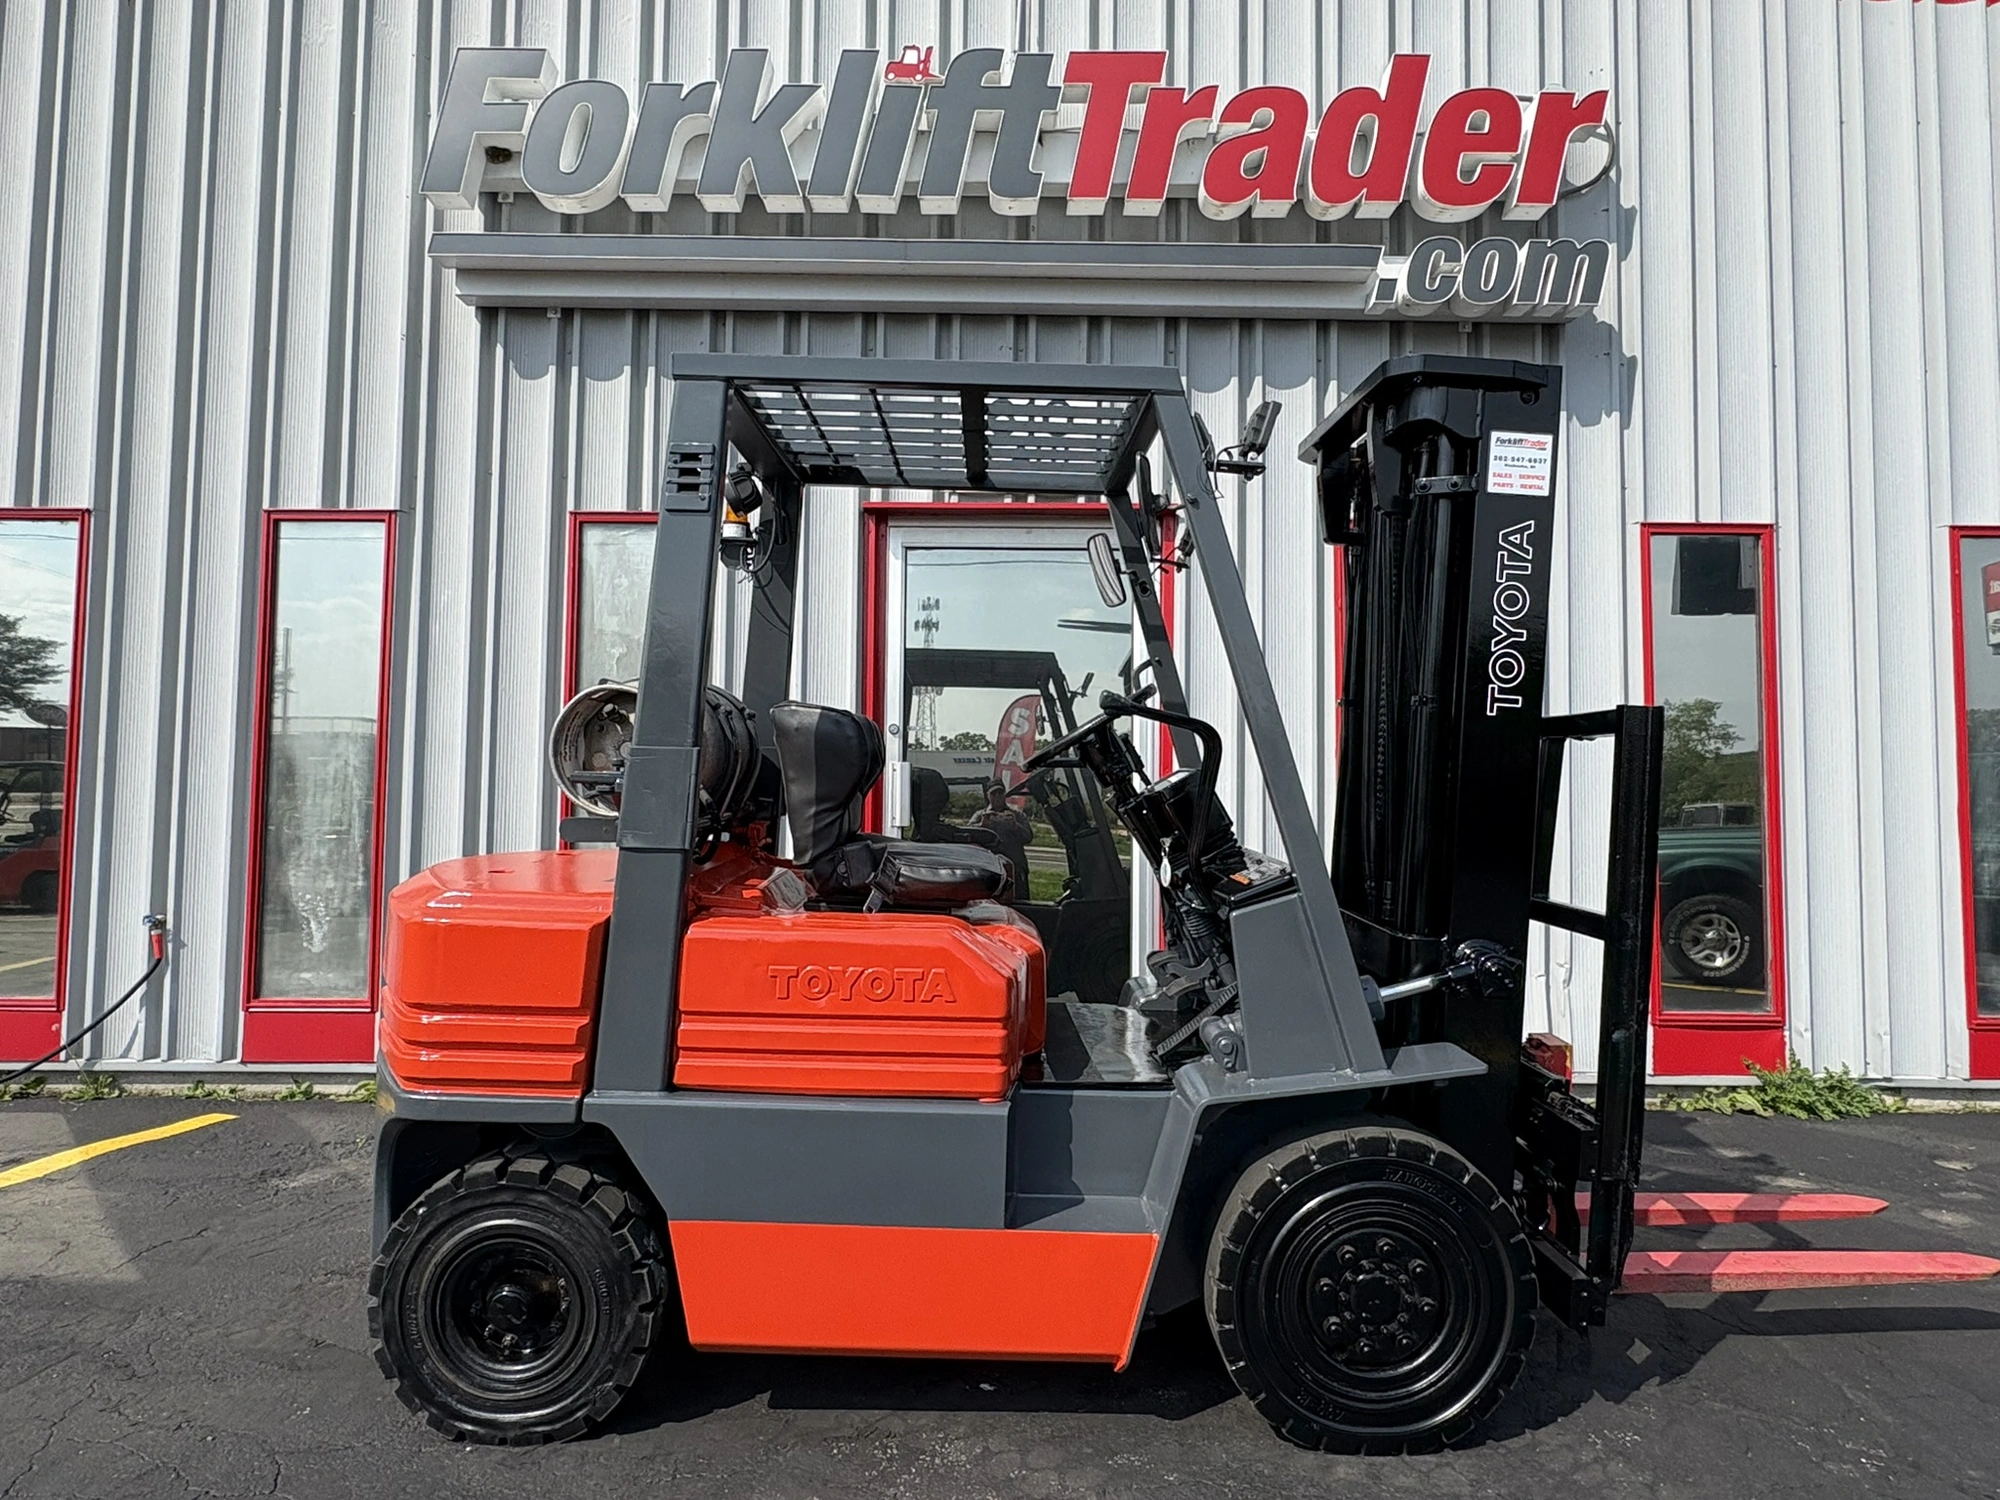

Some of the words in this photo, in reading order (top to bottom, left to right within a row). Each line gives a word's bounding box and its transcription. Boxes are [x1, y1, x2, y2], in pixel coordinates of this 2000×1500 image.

[420, 46, 1610, 207] ForkliftTrader
[1375, 236, 1610, 305] .com
[1519, 483, 1545, 491] RENTAL
[1487, 520, 1535, 715] TOYOTA
[768, 965, 957, 1004] TOYOTA
